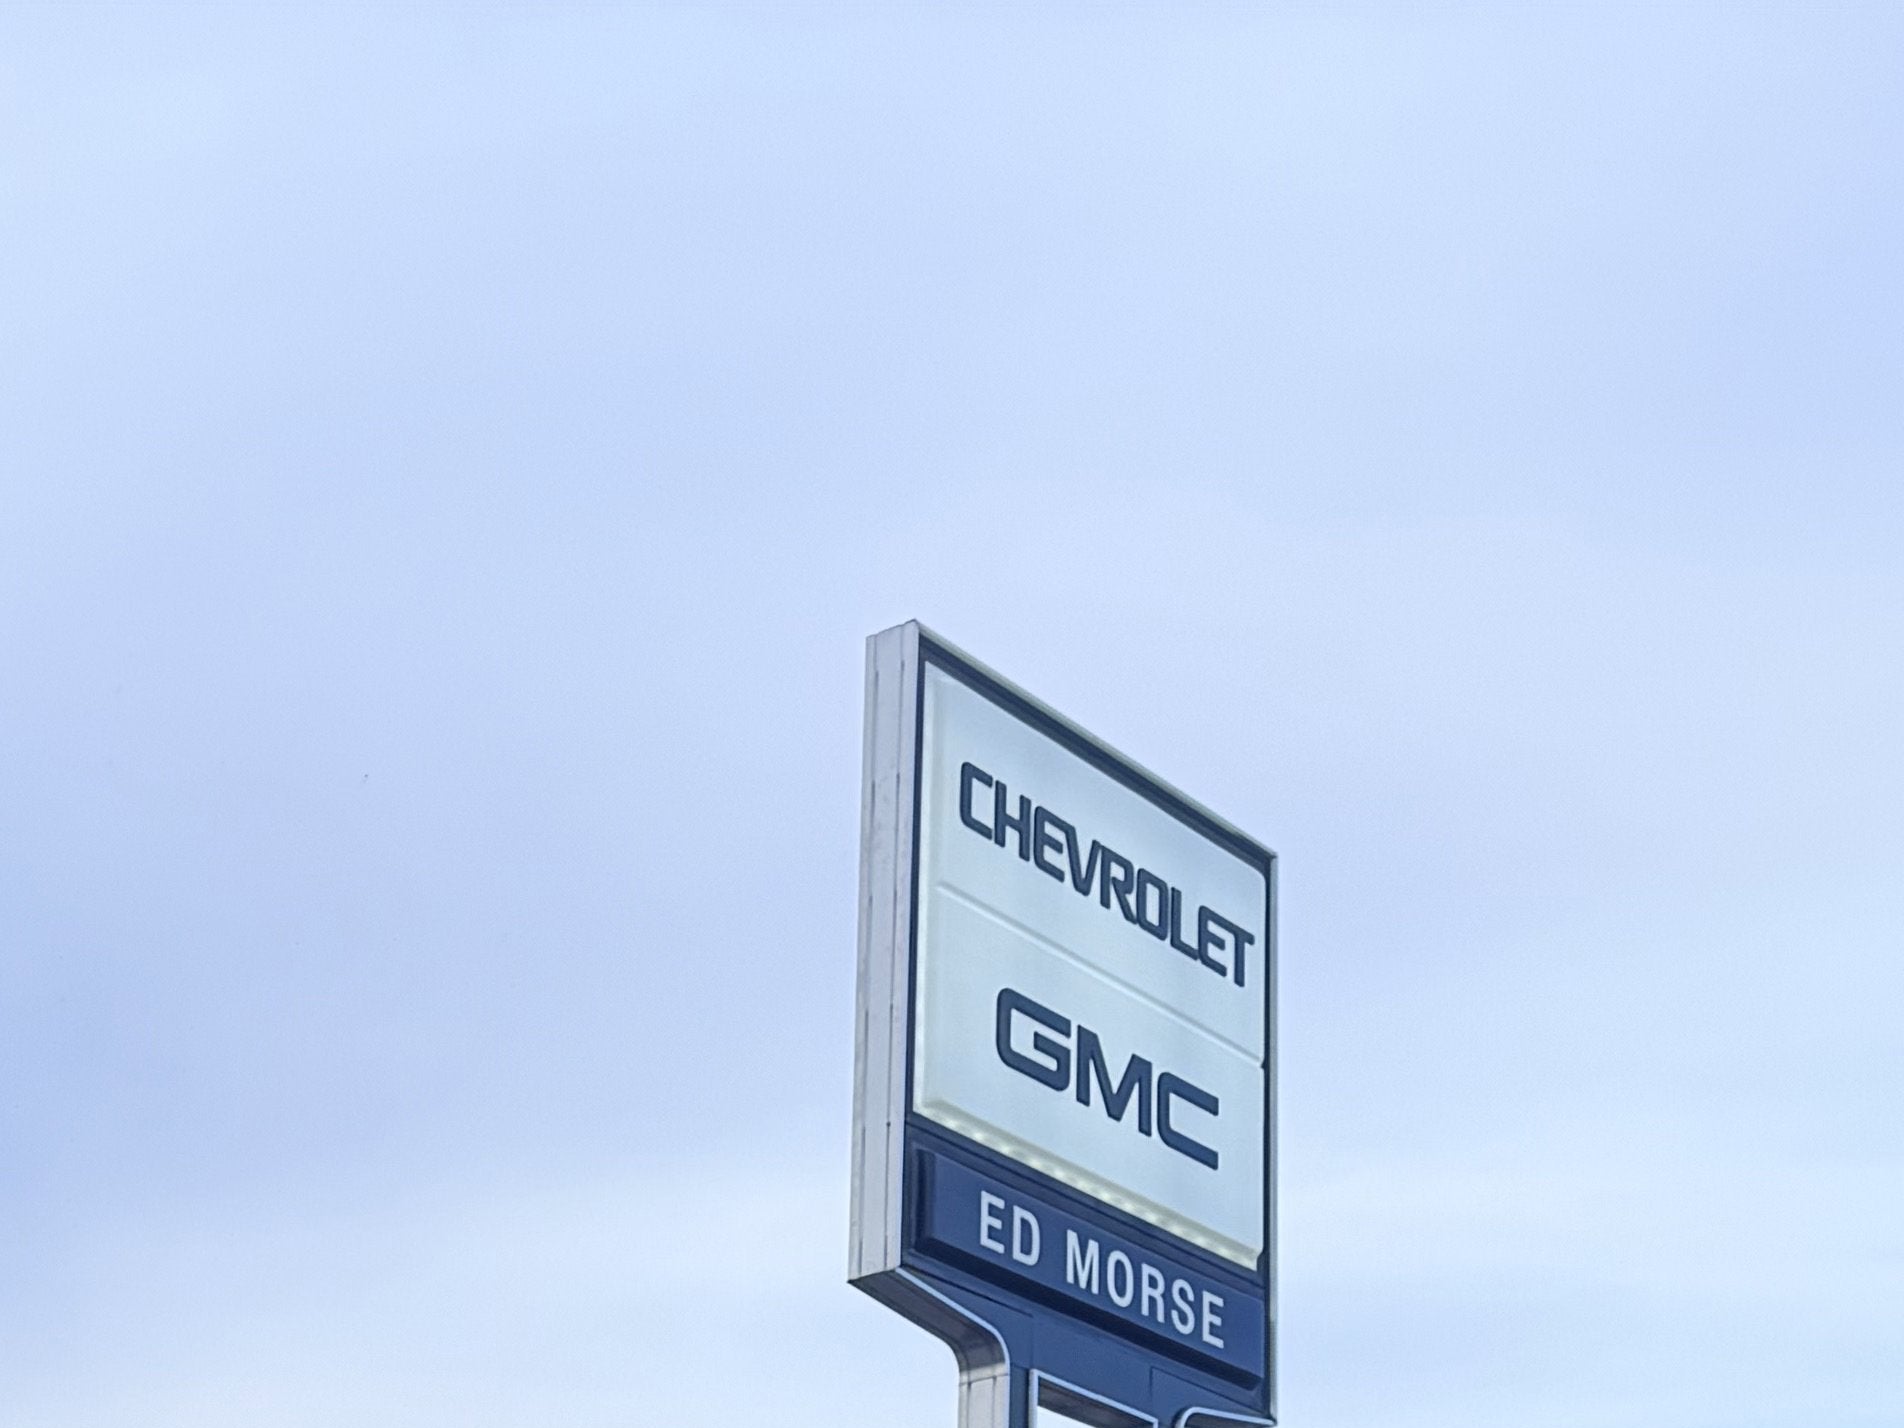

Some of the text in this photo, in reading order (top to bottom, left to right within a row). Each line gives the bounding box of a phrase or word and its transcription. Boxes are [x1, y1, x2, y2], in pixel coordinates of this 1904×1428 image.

[960, 762, 1255, 987] CHEVROLET
[996, 988, 1219, 1169] GMC
[980, 1191, 1225, 1349] ED MORSE
